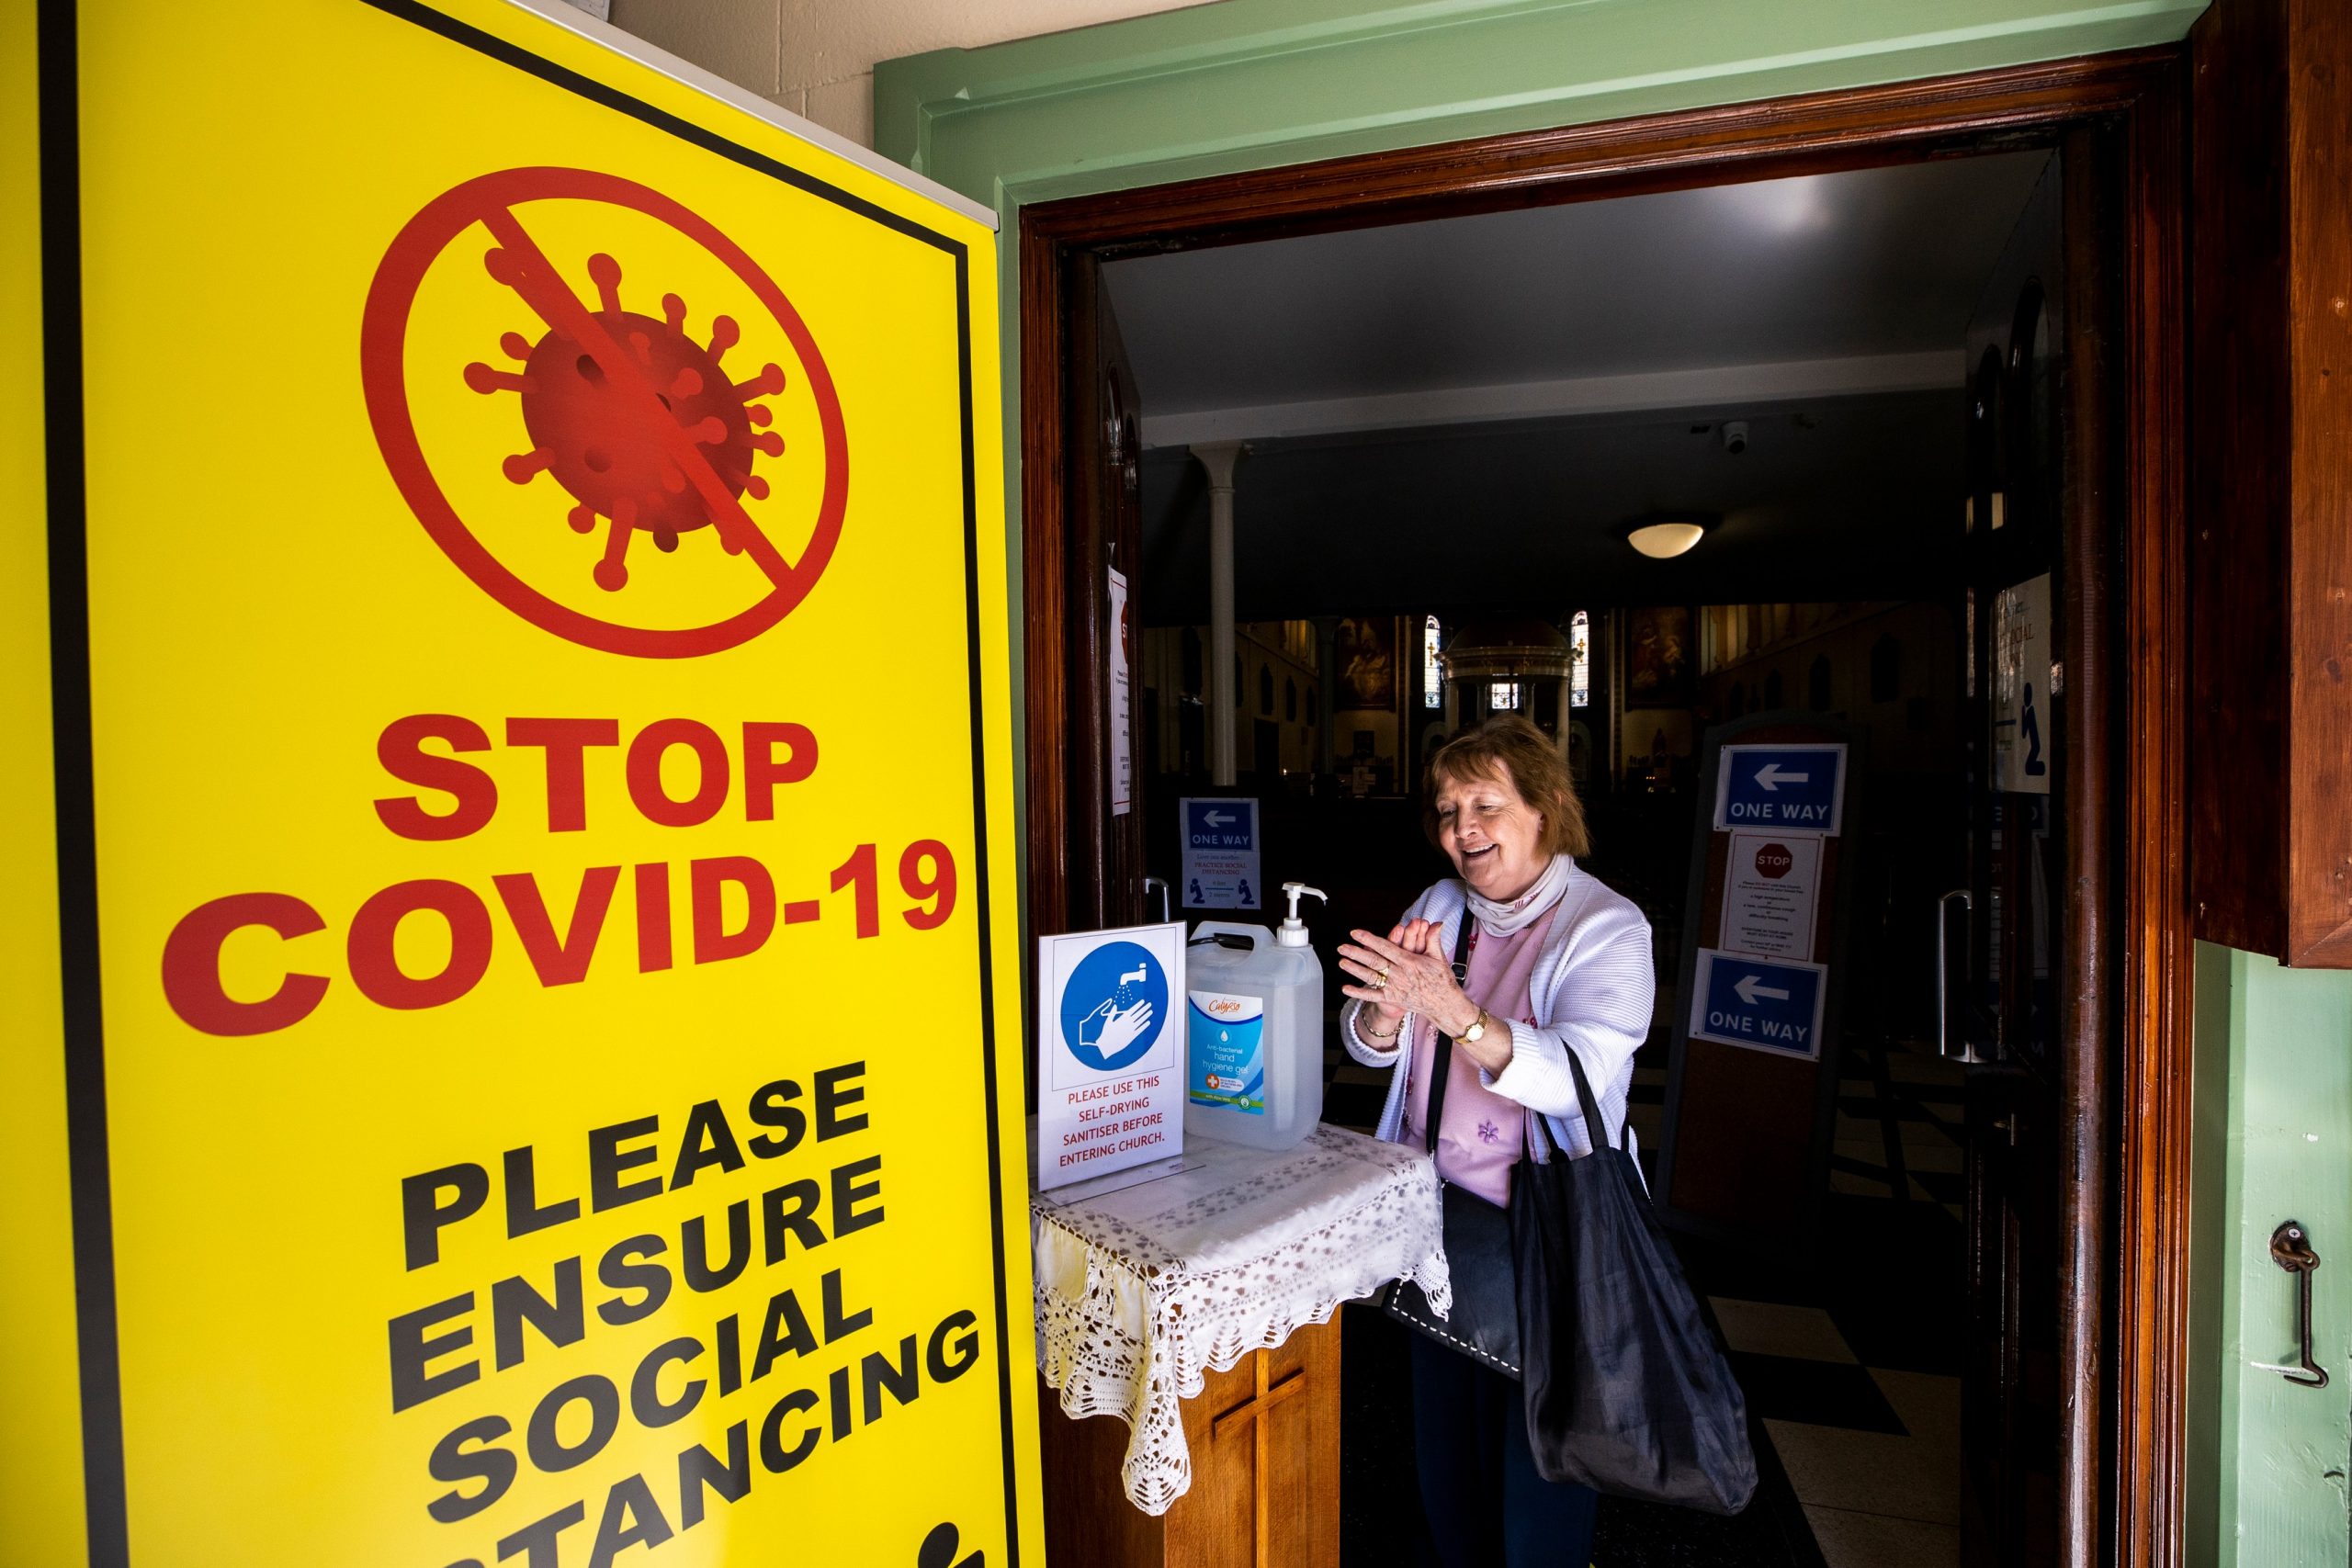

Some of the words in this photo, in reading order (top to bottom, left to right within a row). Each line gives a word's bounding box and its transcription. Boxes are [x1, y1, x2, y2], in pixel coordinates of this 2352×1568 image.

[373, 713, 820, 841] STOP
[1730, 802, 1773, 818] ONE
[1781, 804, 1828, 820] WAY
[1192, 834, 1218, 844] ONE
[1222, 835, 1250, 846] WAY
[1757, 854, 1791, 867] STOP
[162, 838, 958, 1038] COVID-19
[1208, 998, 1241, 1014] Calypso
[1710, 1011, 1753, 1032] ONE
[1761, 1021, 1808, 1043] WAY
[1206, 1044, 1243, 1055] Anti-bacterial
[1214, 1052, 1235, 1063] hand
[1202, 1059, 1234, 1073] hygiene
[1235, 1065, 1250, 1076] gel
[1068, 1086, 1110, 1104] PLEASE
[1113, 1081, 1133, 1095] USE
[1136, 1076, 1159, 1090] THIS
[1079, 1097, 1150, 1122] SELF-DRYING
[1063, 1122, 1120, 1146] SANITISER
[1123, 1112, 1163, 1133] BEFORE
[1059, 1143, 1115, 1168] ENTERING
[1118, 1132, 1165, 1152] CHURCH.
[401, 1060, 869, 1272] PLEASE
[388, 1154, 886, 1415] ENSURE
[427, 1268, 874, 1525] SOCIAL
[439, 1309, 979, 1568] TANCING
